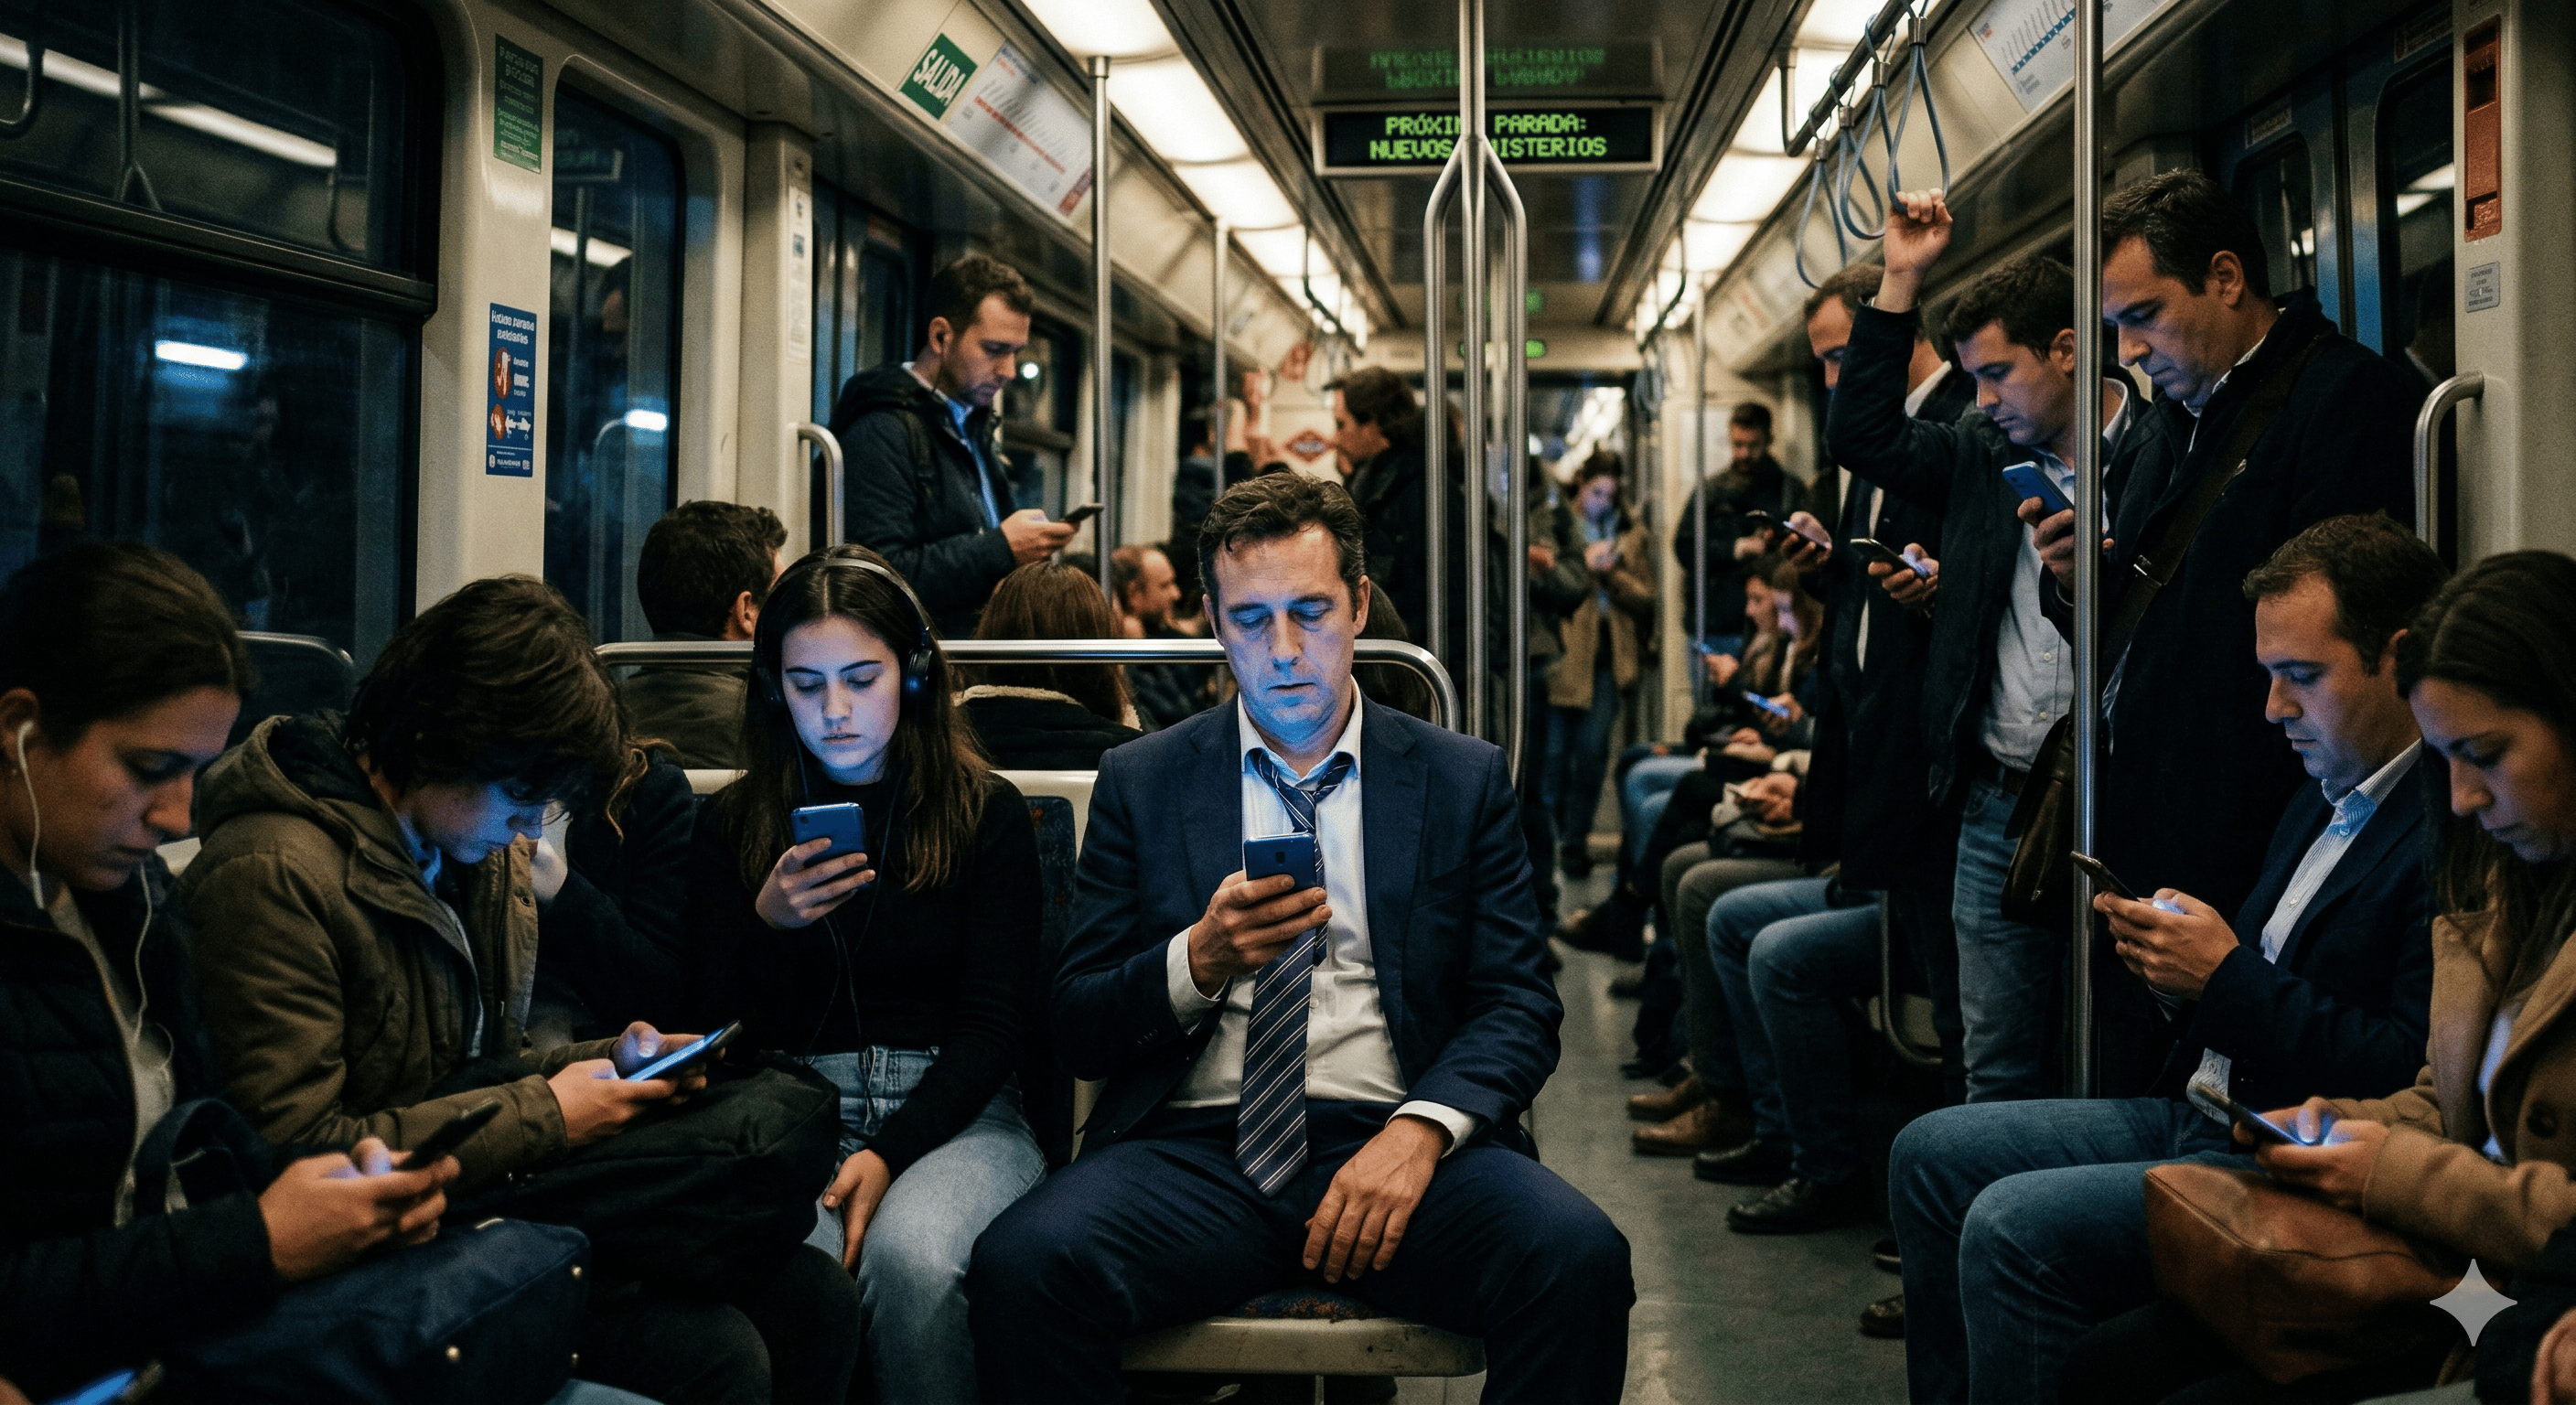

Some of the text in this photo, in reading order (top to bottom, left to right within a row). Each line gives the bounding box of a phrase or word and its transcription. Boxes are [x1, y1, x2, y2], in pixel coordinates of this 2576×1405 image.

[913, 48, 966, 107] SALIDA
[1385, 113, 1586, 136] PRÓXI PARADA:
[1370, 136, 1607, 160] NUEVOS ISTERIOS
